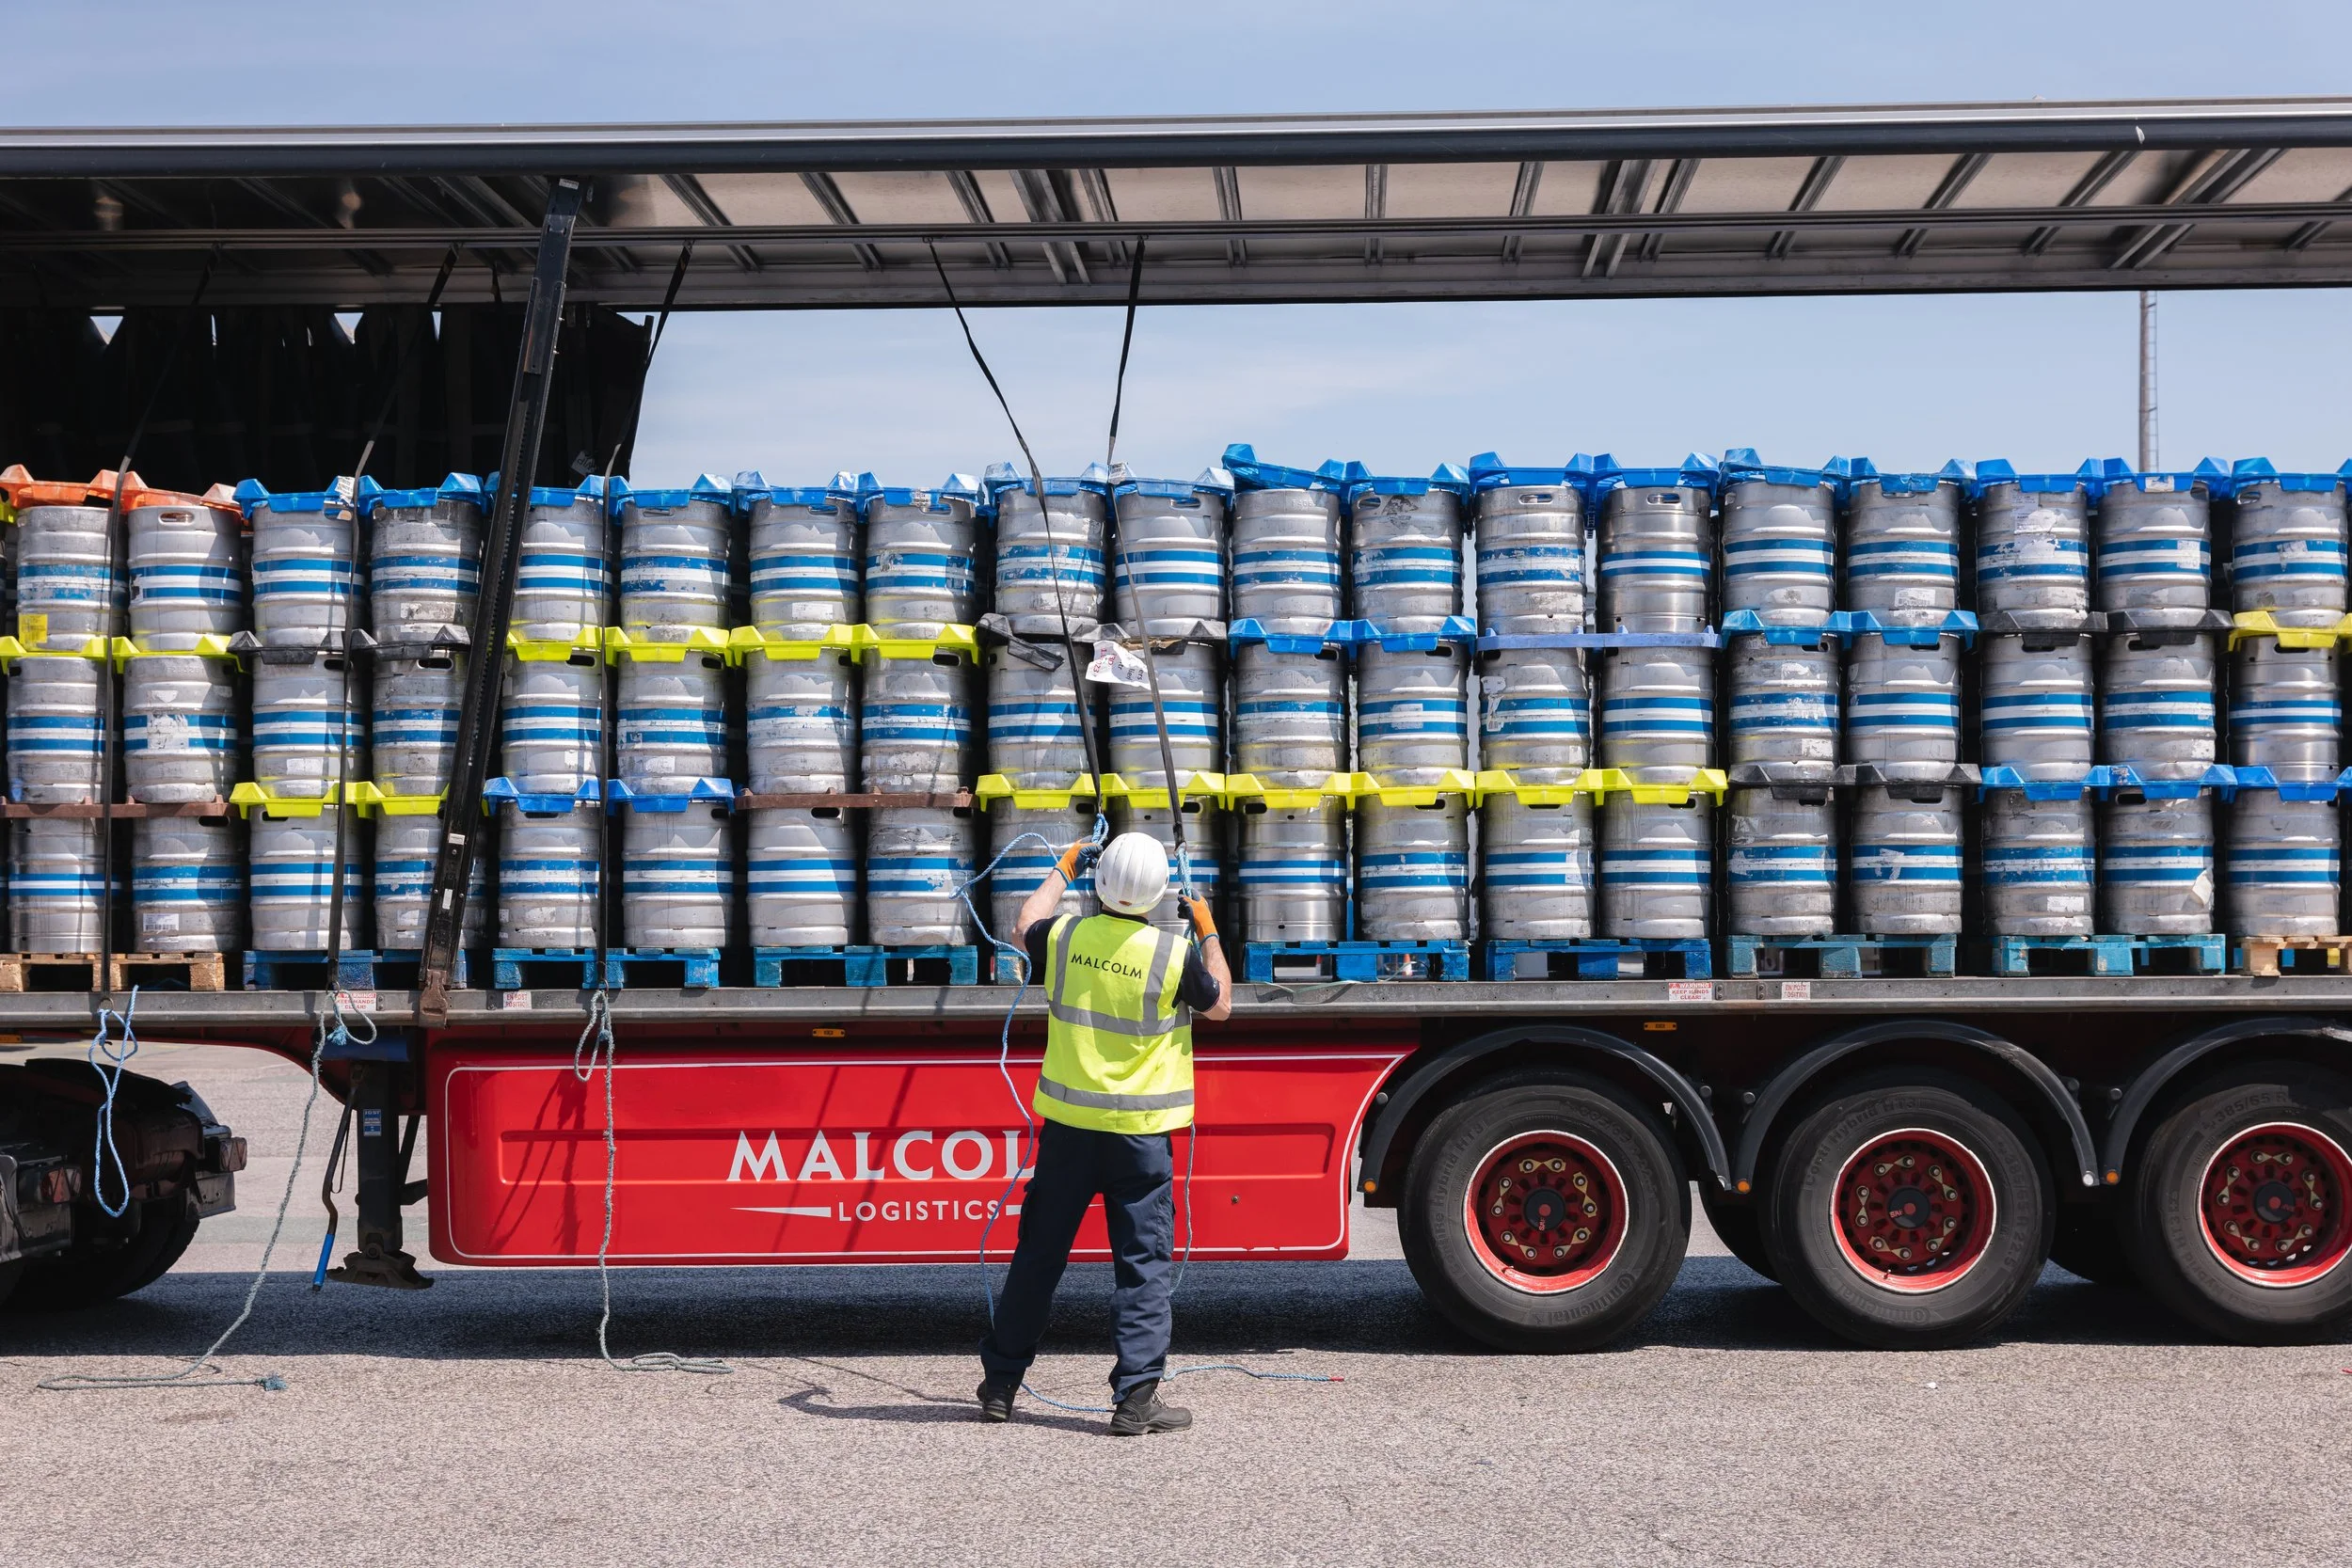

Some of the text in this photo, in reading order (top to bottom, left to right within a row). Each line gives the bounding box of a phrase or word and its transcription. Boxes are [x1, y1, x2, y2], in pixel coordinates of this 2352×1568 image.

[1071, 953, 1142, 979] MALCOLM
[726, 1130, 1035, 1181] MALCOL
[838, 1200, 1000, 1222] LOGISTICS
